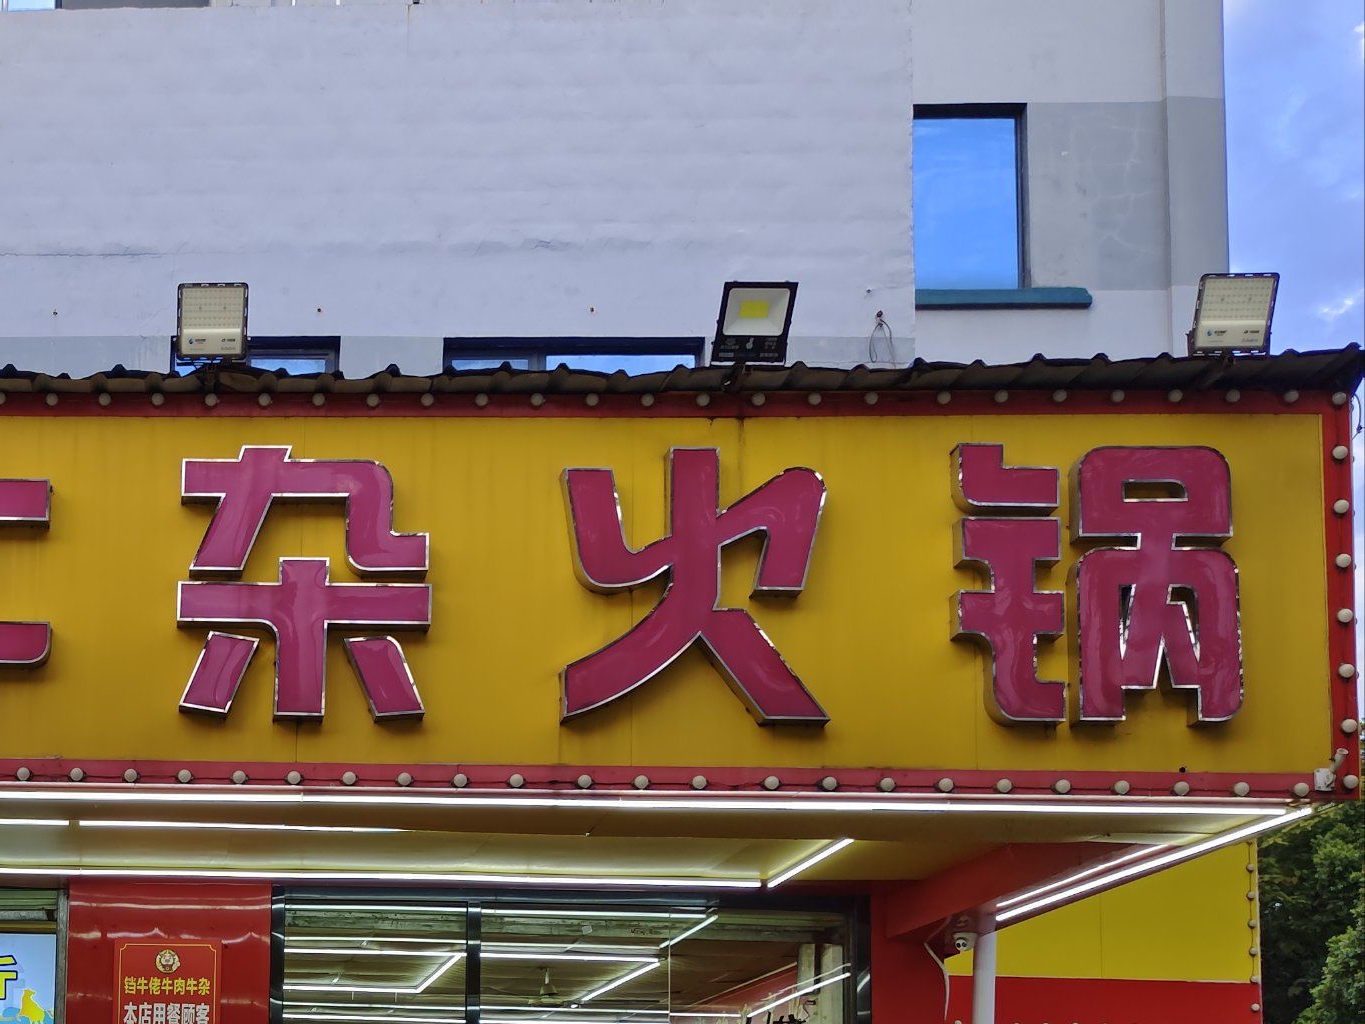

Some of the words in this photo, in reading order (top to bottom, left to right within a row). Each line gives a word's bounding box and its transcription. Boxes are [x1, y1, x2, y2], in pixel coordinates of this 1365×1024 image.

[123, 976, 211, 995] 铛牛佬牛肉牛杂
